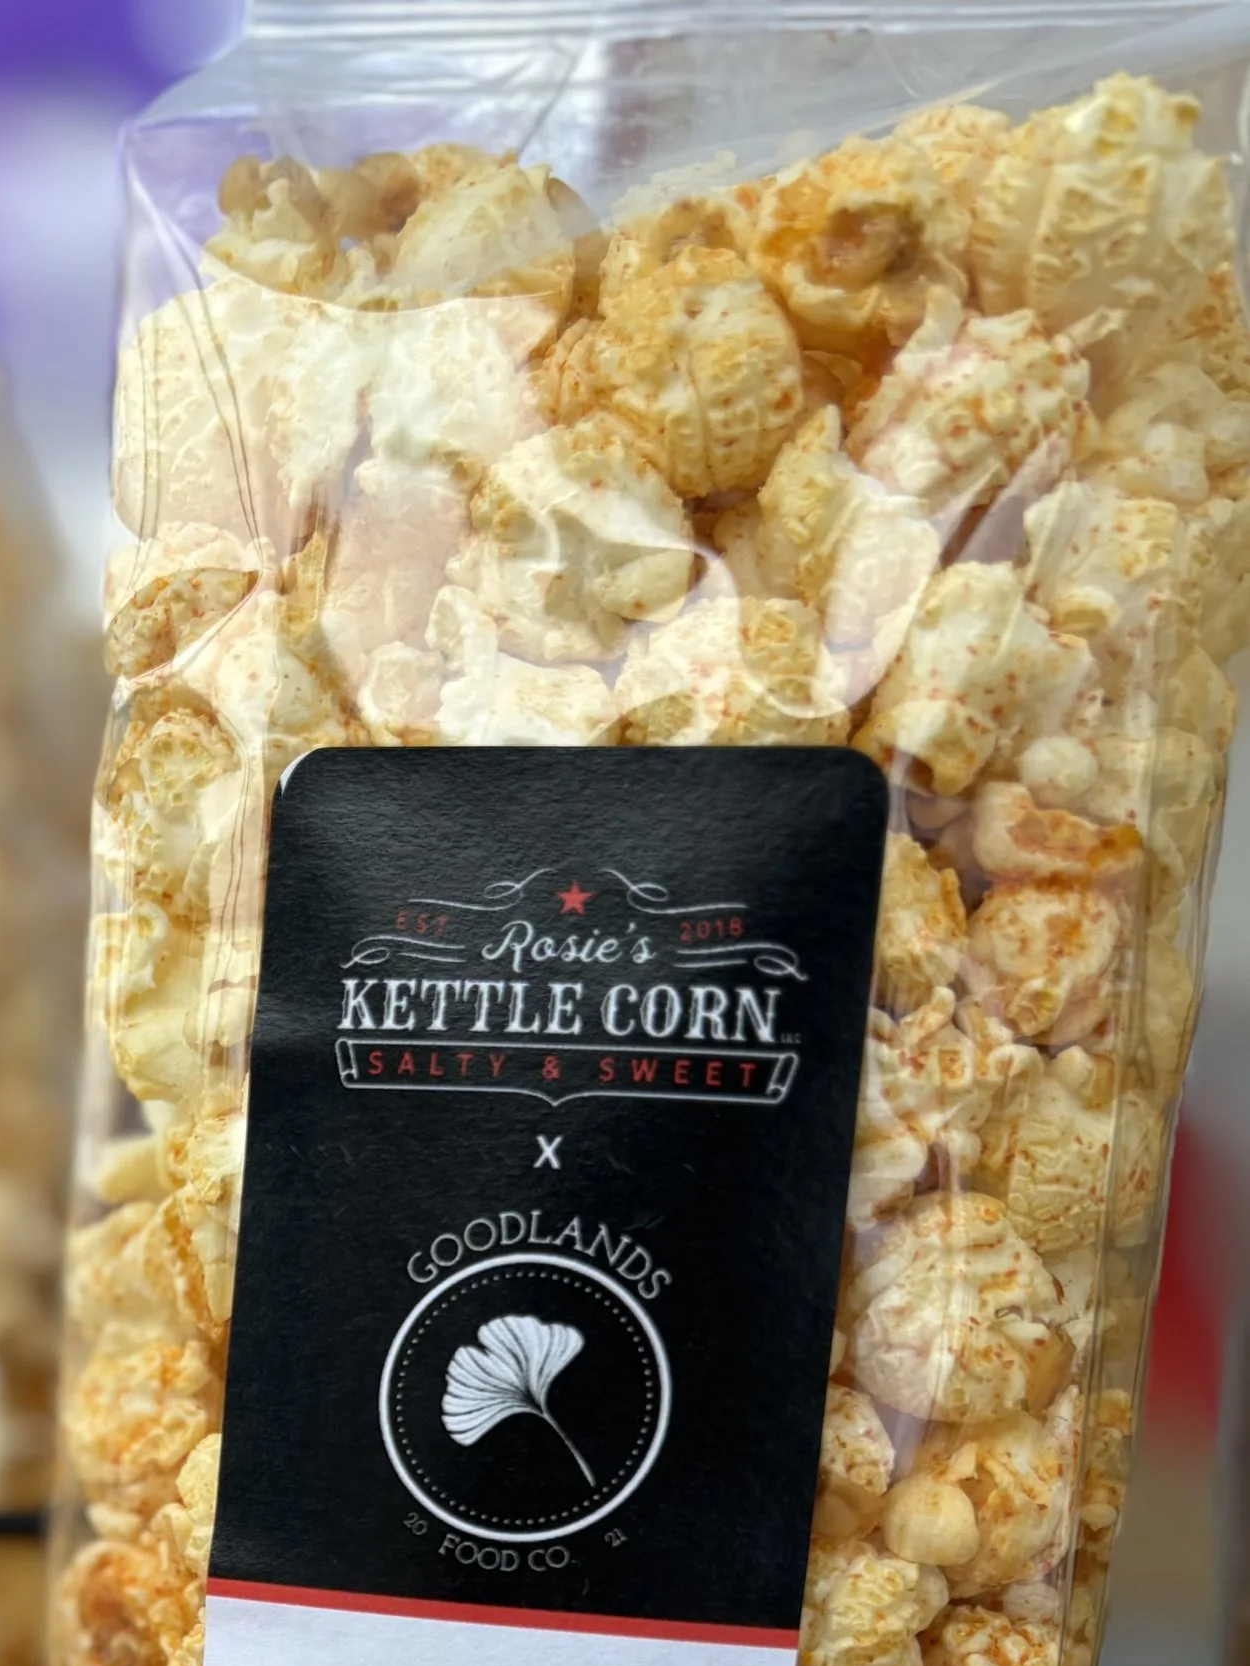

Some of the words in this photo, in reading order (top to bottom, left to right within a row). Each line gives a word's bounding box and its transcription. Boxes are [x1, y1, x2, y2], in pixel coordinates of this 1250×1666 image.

[481, 920, 657, 973] Rosie's
[678, 915, 745, 943] 2018
[337, 978, 584, 1036] KETTLE
[600, 984, 781, 1044] CORN
[367, 1051, 507, 1079] SALTY
[541, 1056, 562, 1080] &
[599, 1057, 757, 1088] SWEET
[406, 1210, 673, 1299] GOODLANDS
[403, 1511, 429, 1536] 20
[438, 1533, 520, 1572] FOOD
[604, 1527, 628, 1548] 21
